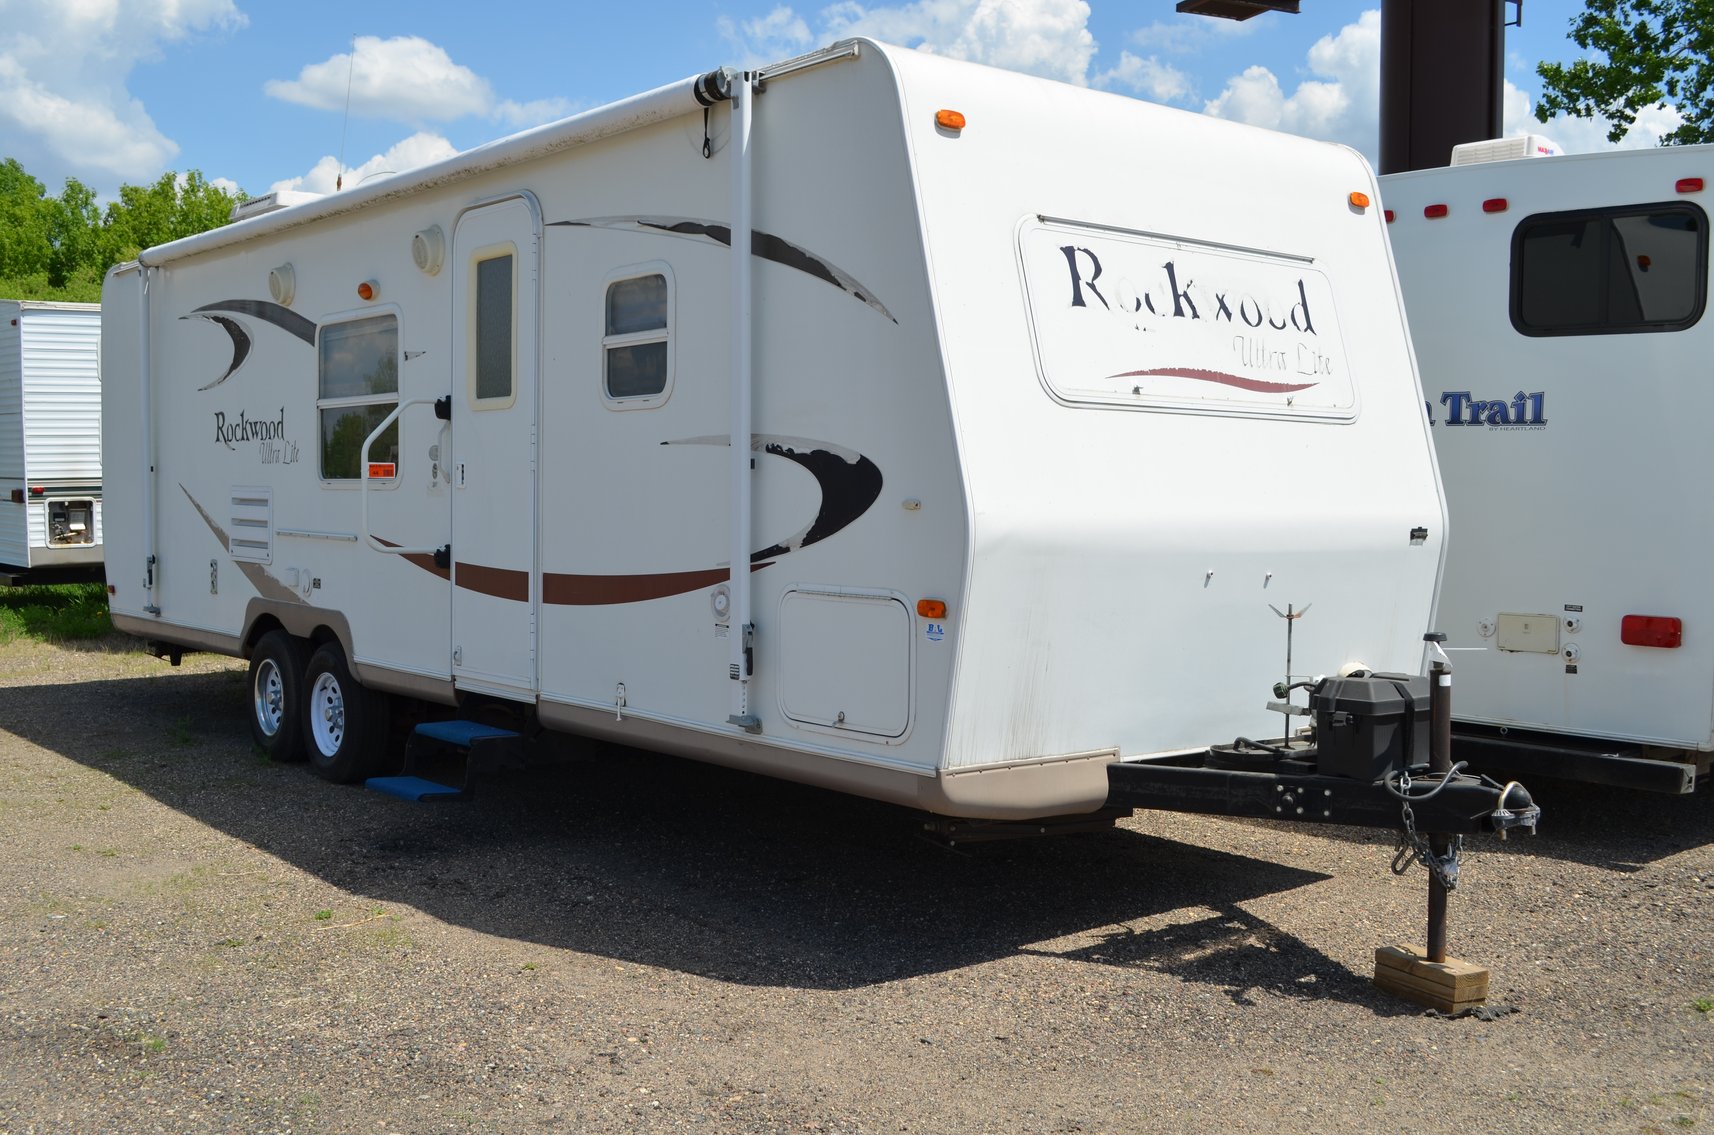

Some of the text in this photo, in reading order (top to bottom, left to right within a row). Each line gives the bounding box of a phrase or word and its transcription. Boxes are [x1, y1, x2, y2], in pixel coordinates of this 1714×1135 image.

[1440, 391, 1549, 426] Trail
[214, 406, 285, 450] Rockwood
[283, 440, 300, 465] Lite
